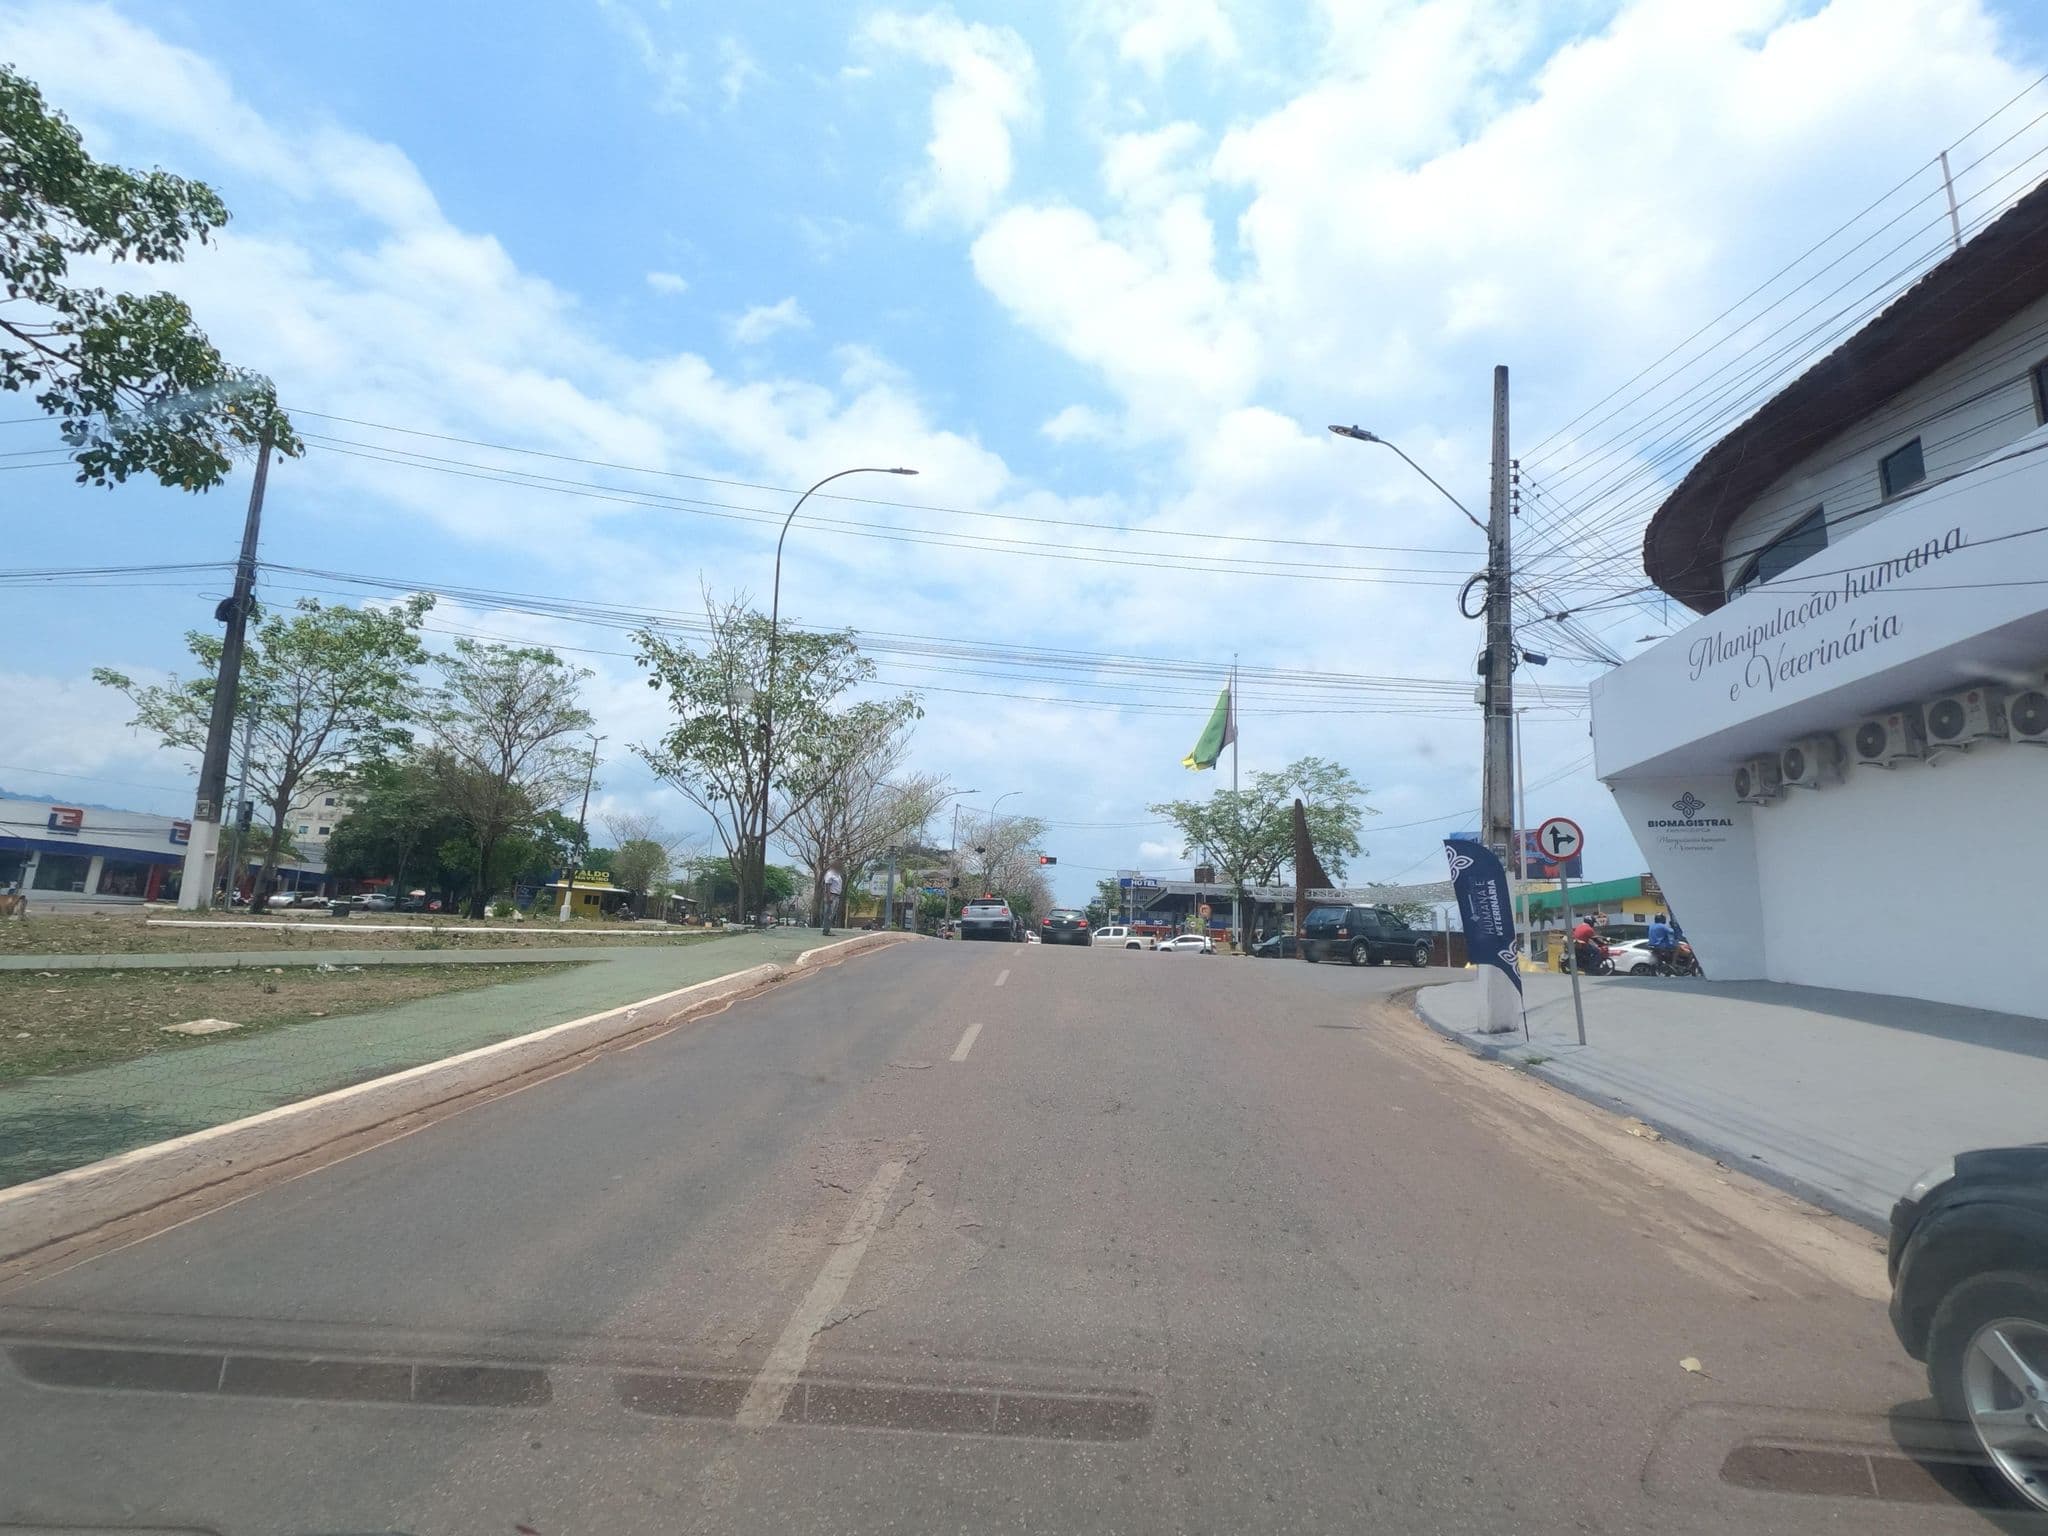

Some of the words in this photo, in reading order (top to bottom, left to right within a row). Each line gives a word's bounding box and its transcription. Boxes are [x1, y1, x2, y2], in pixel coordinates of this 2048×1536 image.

[1688, 589, 1838, 681] Manipulação
[1844, 526, 1969, 603] humana
[1729, 682, 1742, 702] e
[1744, 614, 1904, 693] Veterinária
[1647, 818, 1733, 828] BIOMAGISTRAL
[1131, 879, 1157, 887] HOTEL
[1477, 889, 1495, 936] HUMANA
